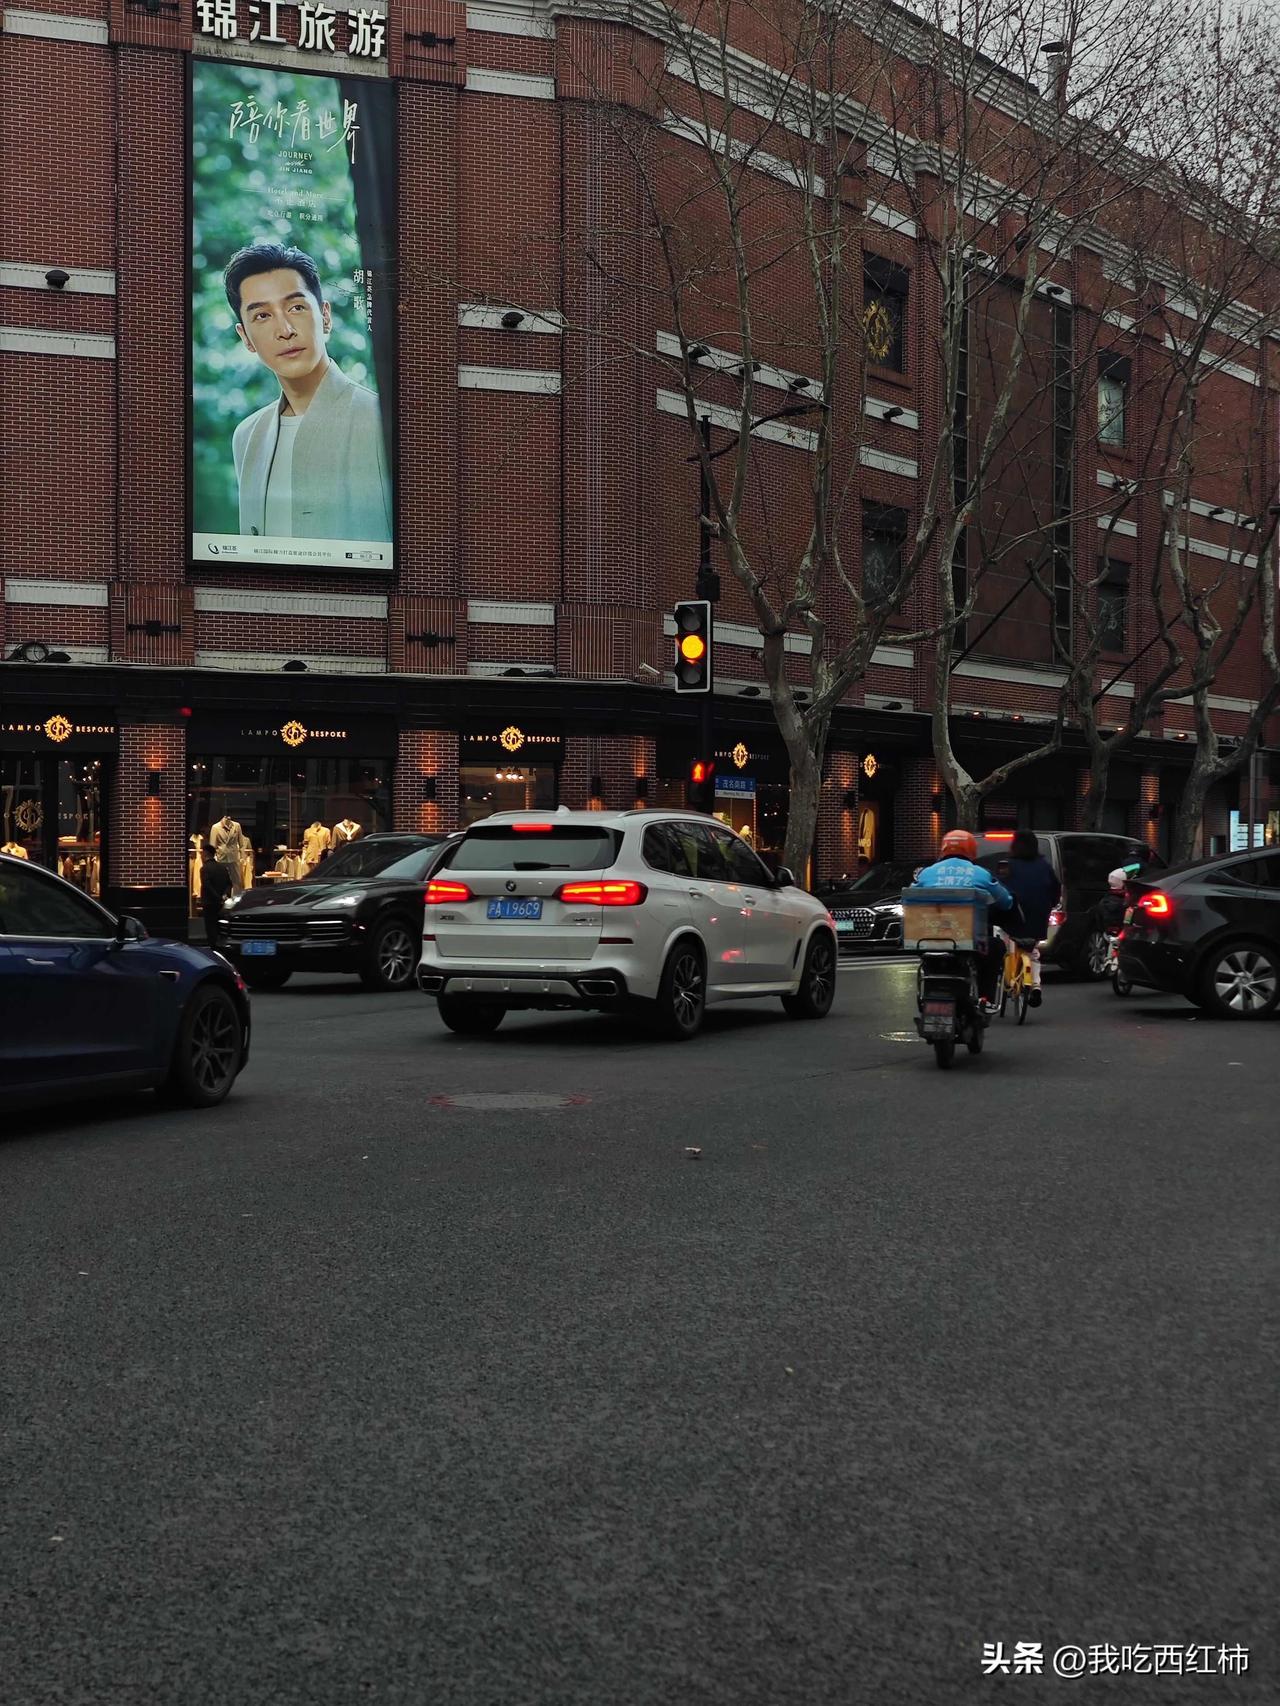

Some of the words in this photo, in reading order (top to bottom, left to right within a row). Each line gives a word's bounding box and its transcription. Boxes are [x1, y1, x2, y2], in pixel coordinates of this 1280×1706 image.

[197, 0, 386, 58] 锦江旅游
[228, 94, 361, 164] 陪你看世界
[278, 150, 313, 161] JOURNEY
[353, 268, 365, 311] 胡歌
[1, 723, 41, 732] LAMPO
[75, 725, 115, 734] BESPOKE
[241, 729, 278, 737] LAMPO
[309, 730, 347, 738] BESPOKE
[463, 734, 498, 742] LAMPO
[526, 735, 561, 744] BESPOKE
